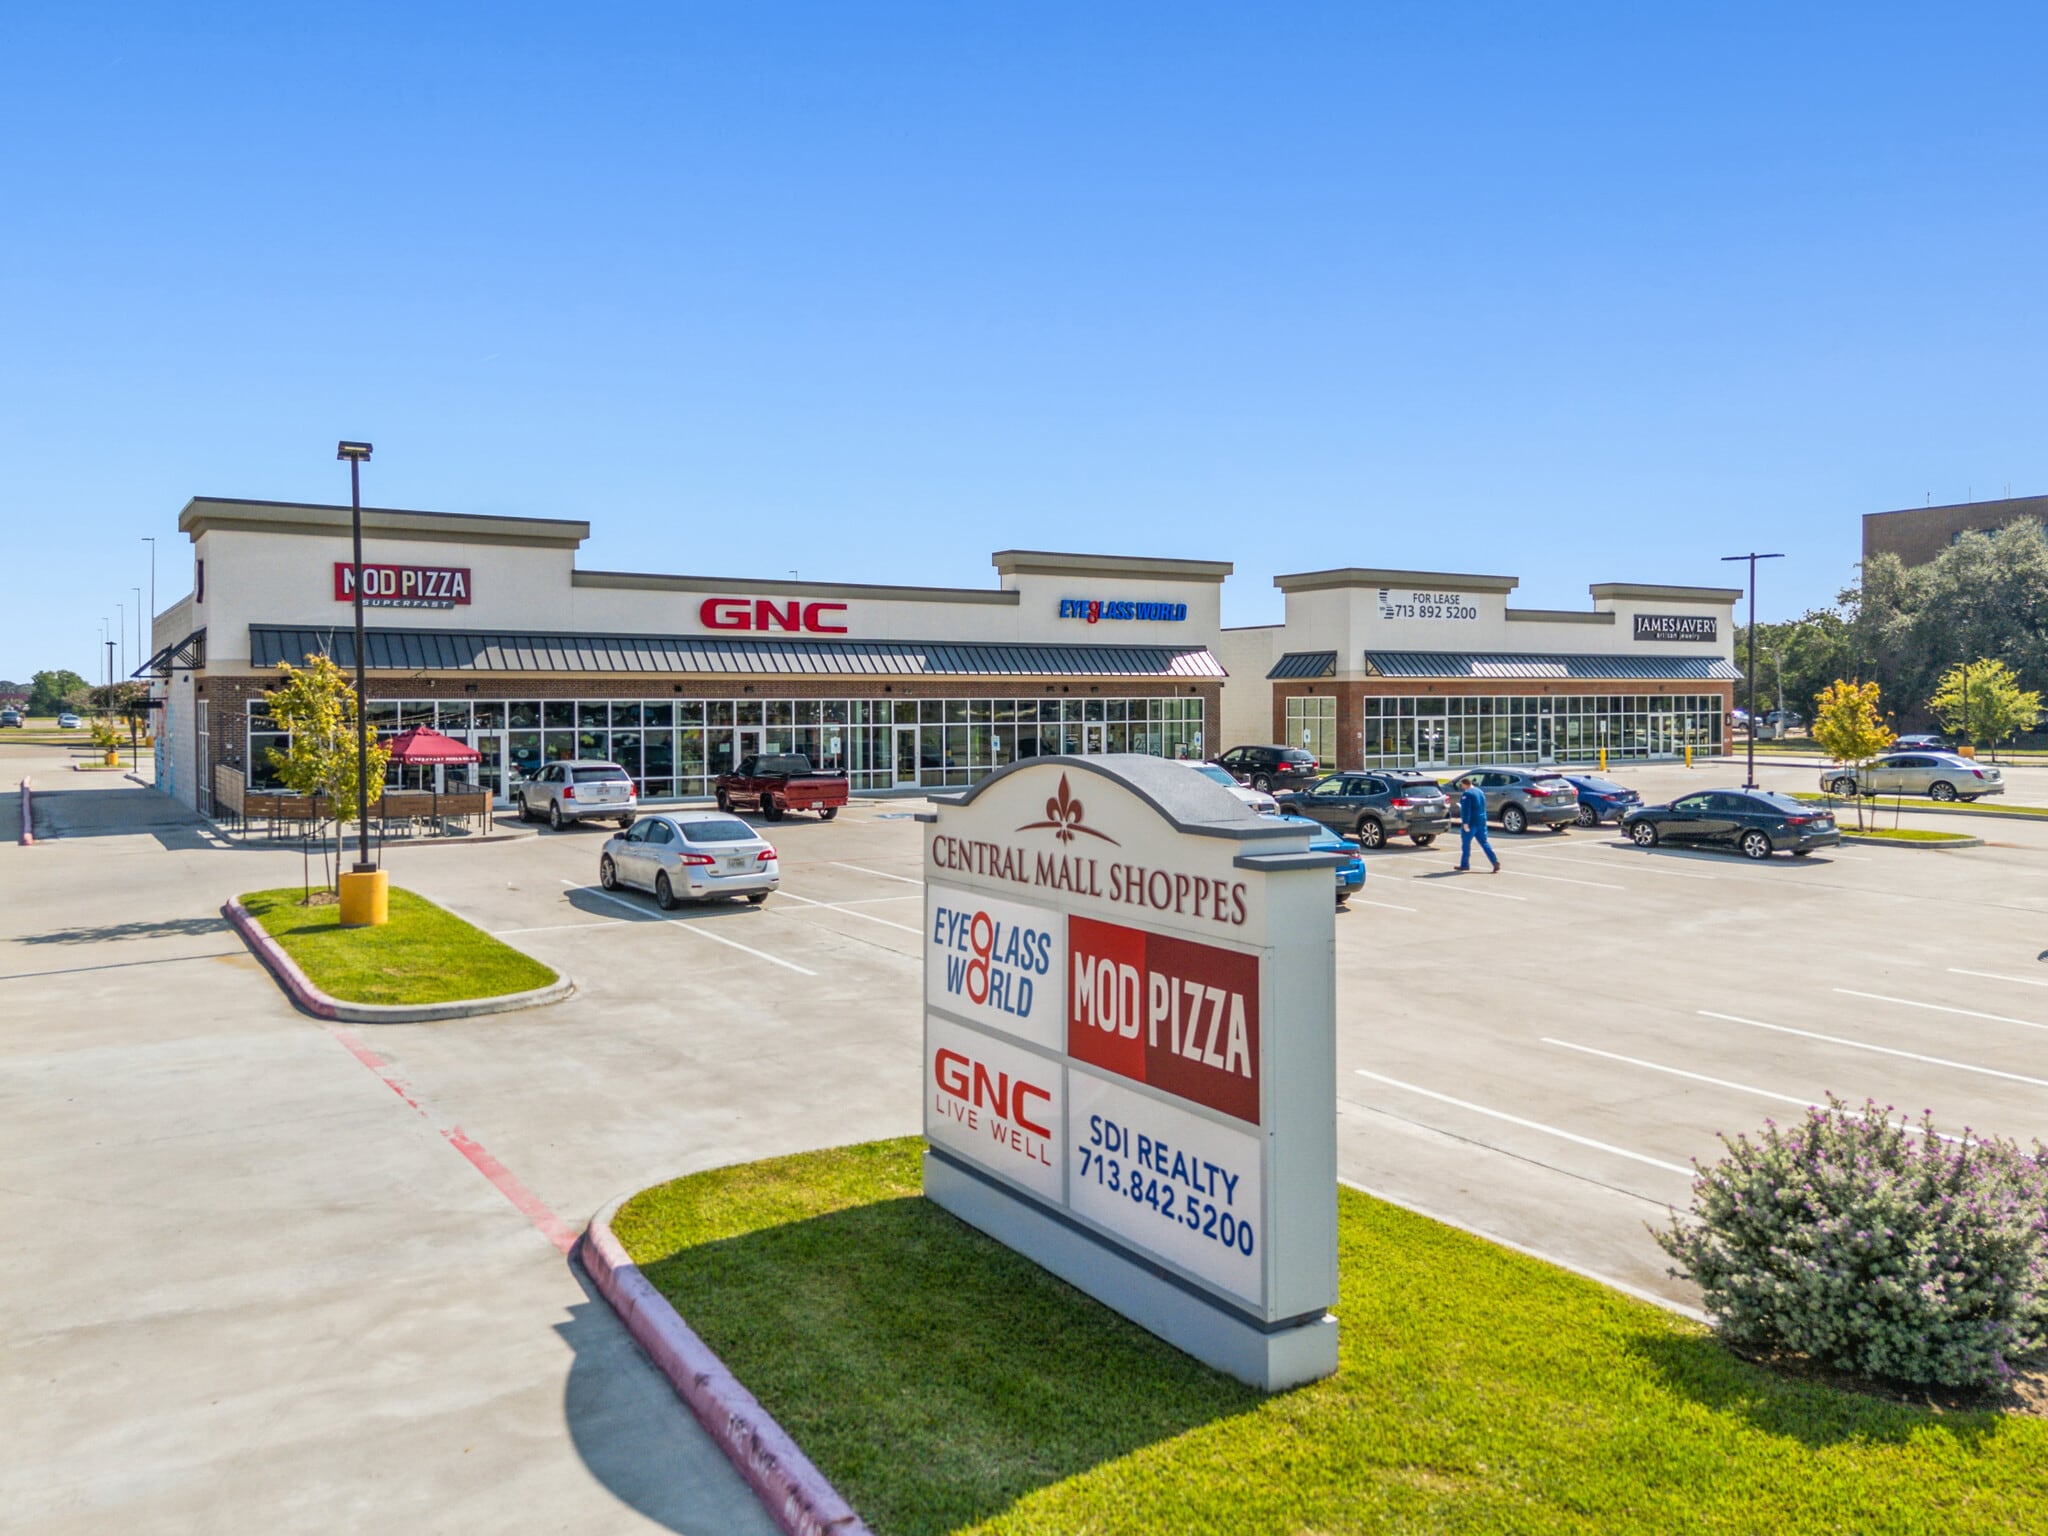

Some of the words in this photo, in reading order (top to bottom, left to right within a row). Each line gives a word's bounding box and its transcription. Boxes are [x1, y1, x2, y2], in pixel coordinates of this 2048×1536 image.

[362, 598, 449, 608] SUPERFAST
[402, 570, 466, 598] PIZZA
[700, 598, 848, 633] GNC
[1060, 599, 1135, 624] EYEGLASS
[1136, 602, 1187, 621] WORLD
[1395, 605, 1414, 618] 713
[1419, 606, 1442, 618] 892
[1446, 607, 1477, 619] 5200
[1413, 593, 1431, 604] FOR
[1434, 594, 1460, 605] LEASE
[1637, 618, 1675, 633] JAMES
[1681, 619, 1717, 633] AVERY
[932, 835, 1029, 884] CENTRAL
[1035, 850, 1102, 897] MALL
[1110, 863, 1247, 926] SHOPPES
[934, 907, 1051, 975] EYEGLASS
[947, 954, 1033, 1018] WORLD
[1074, 951, 1140, 1039] MOD
[1149, 971, 1252, 1078] PIZZA
[935, 1048, 1051, 1140] GNC
[936, 1094, 978, 1130] LIVE
[991, 1119, 1051, 1167] WELL
[1090, 1115, 1128, 1159] SDI
[1138, 1134, 1239, 1206] REALTY
[1079, 1146, 1254, 1256] 713.842.5200
